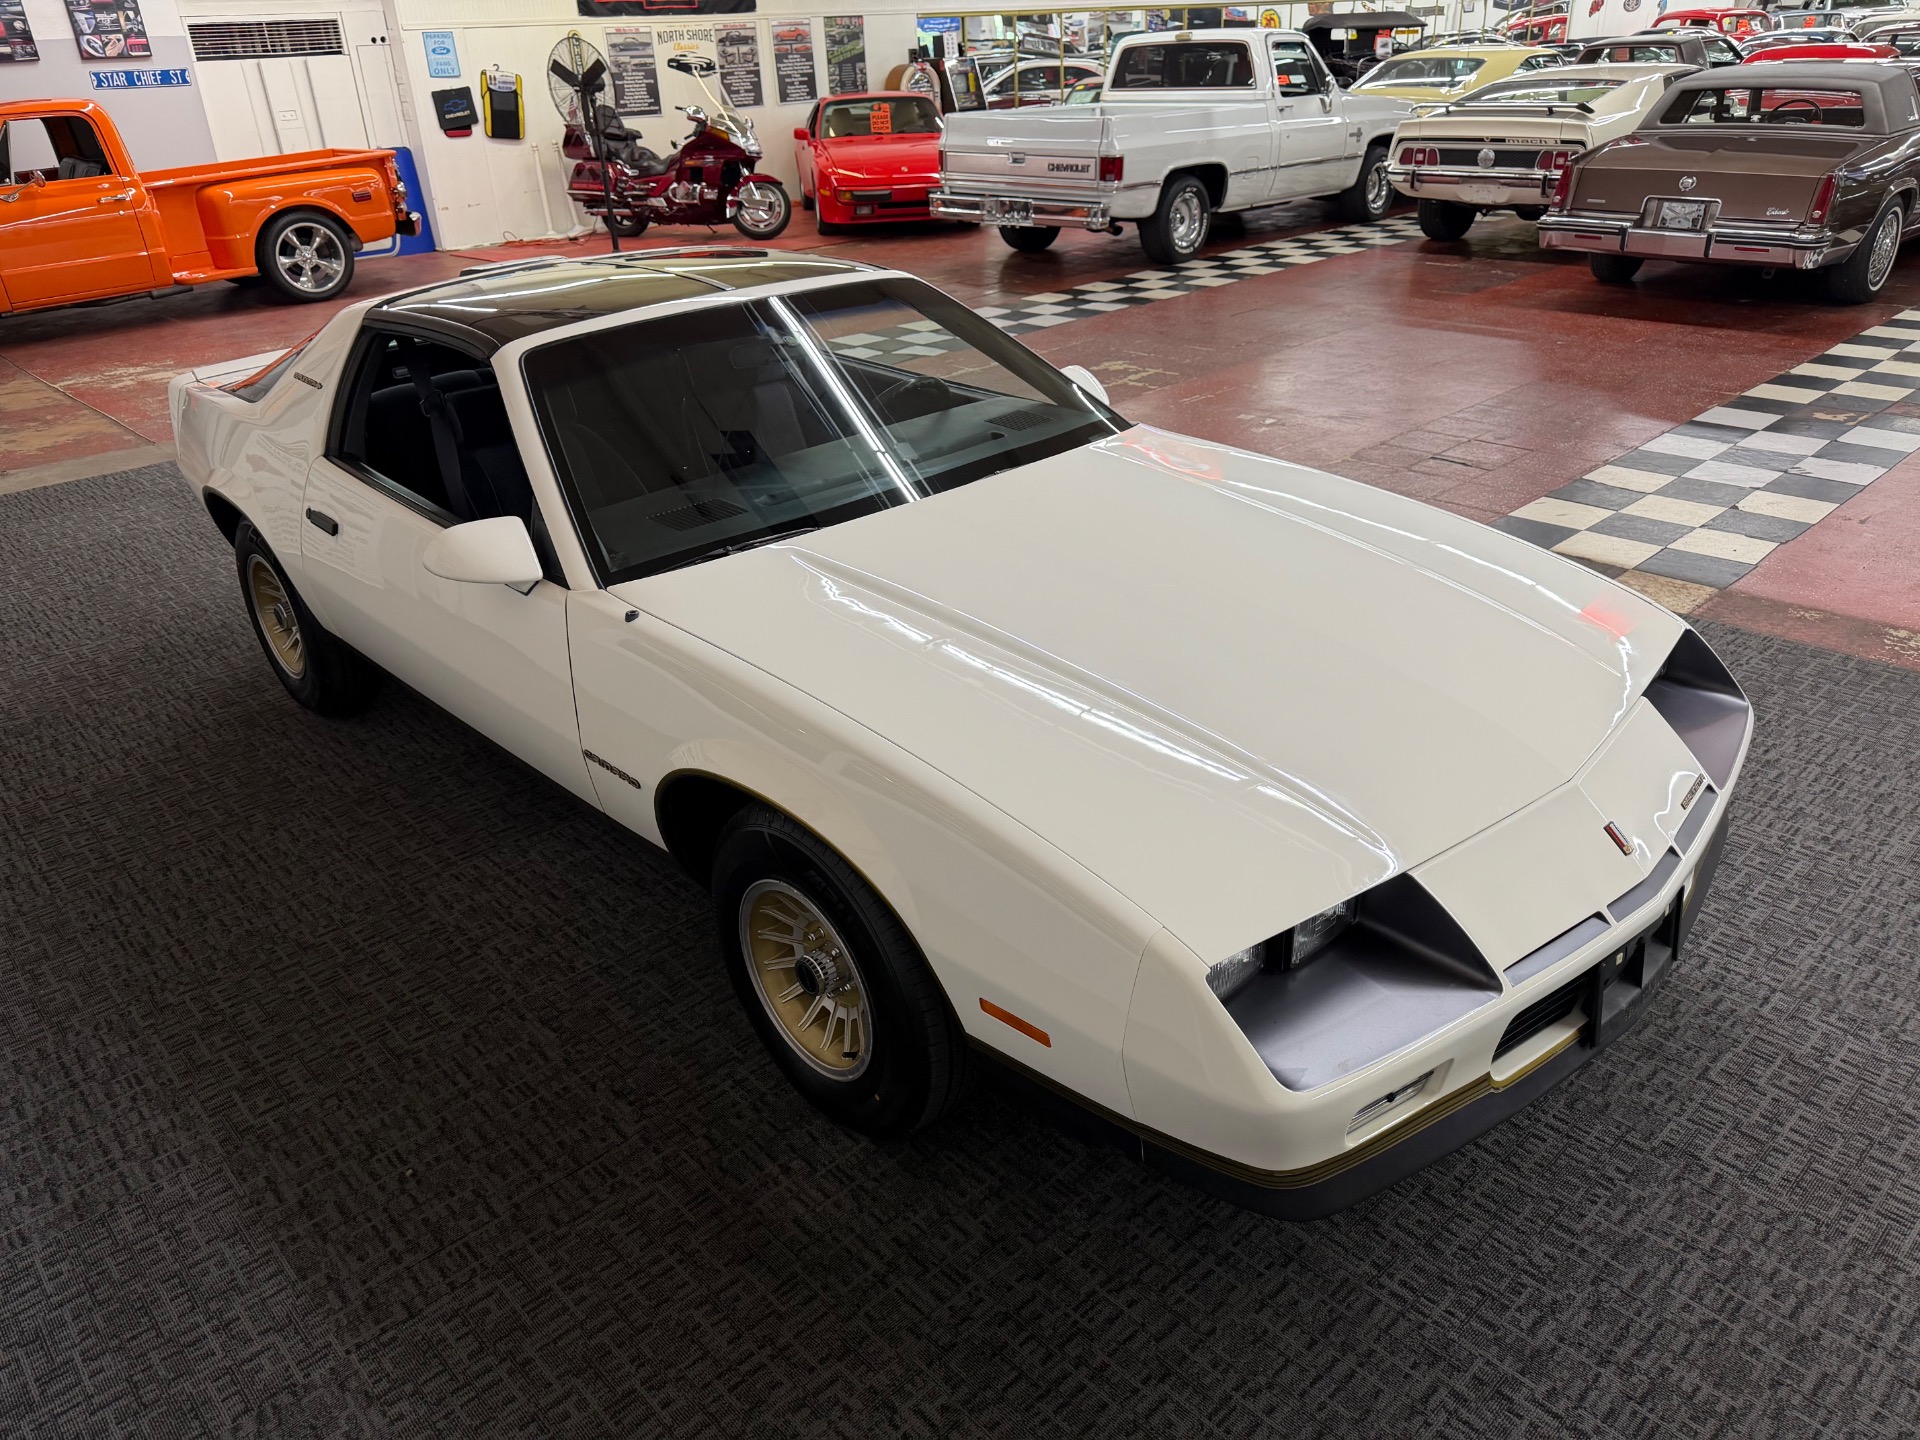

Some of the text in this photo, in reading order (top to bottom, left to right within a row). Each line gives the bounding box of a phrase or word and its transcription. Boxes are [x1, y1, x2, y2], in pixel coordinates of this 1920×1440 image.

[657, 28, 714, 45] NORTH SHORE
[433, 67, 455, 75] ONLY
[99, 70, 182, 87] STAR CHIEF ST
[1047, 163, 1091, 173] CHEVROLET
